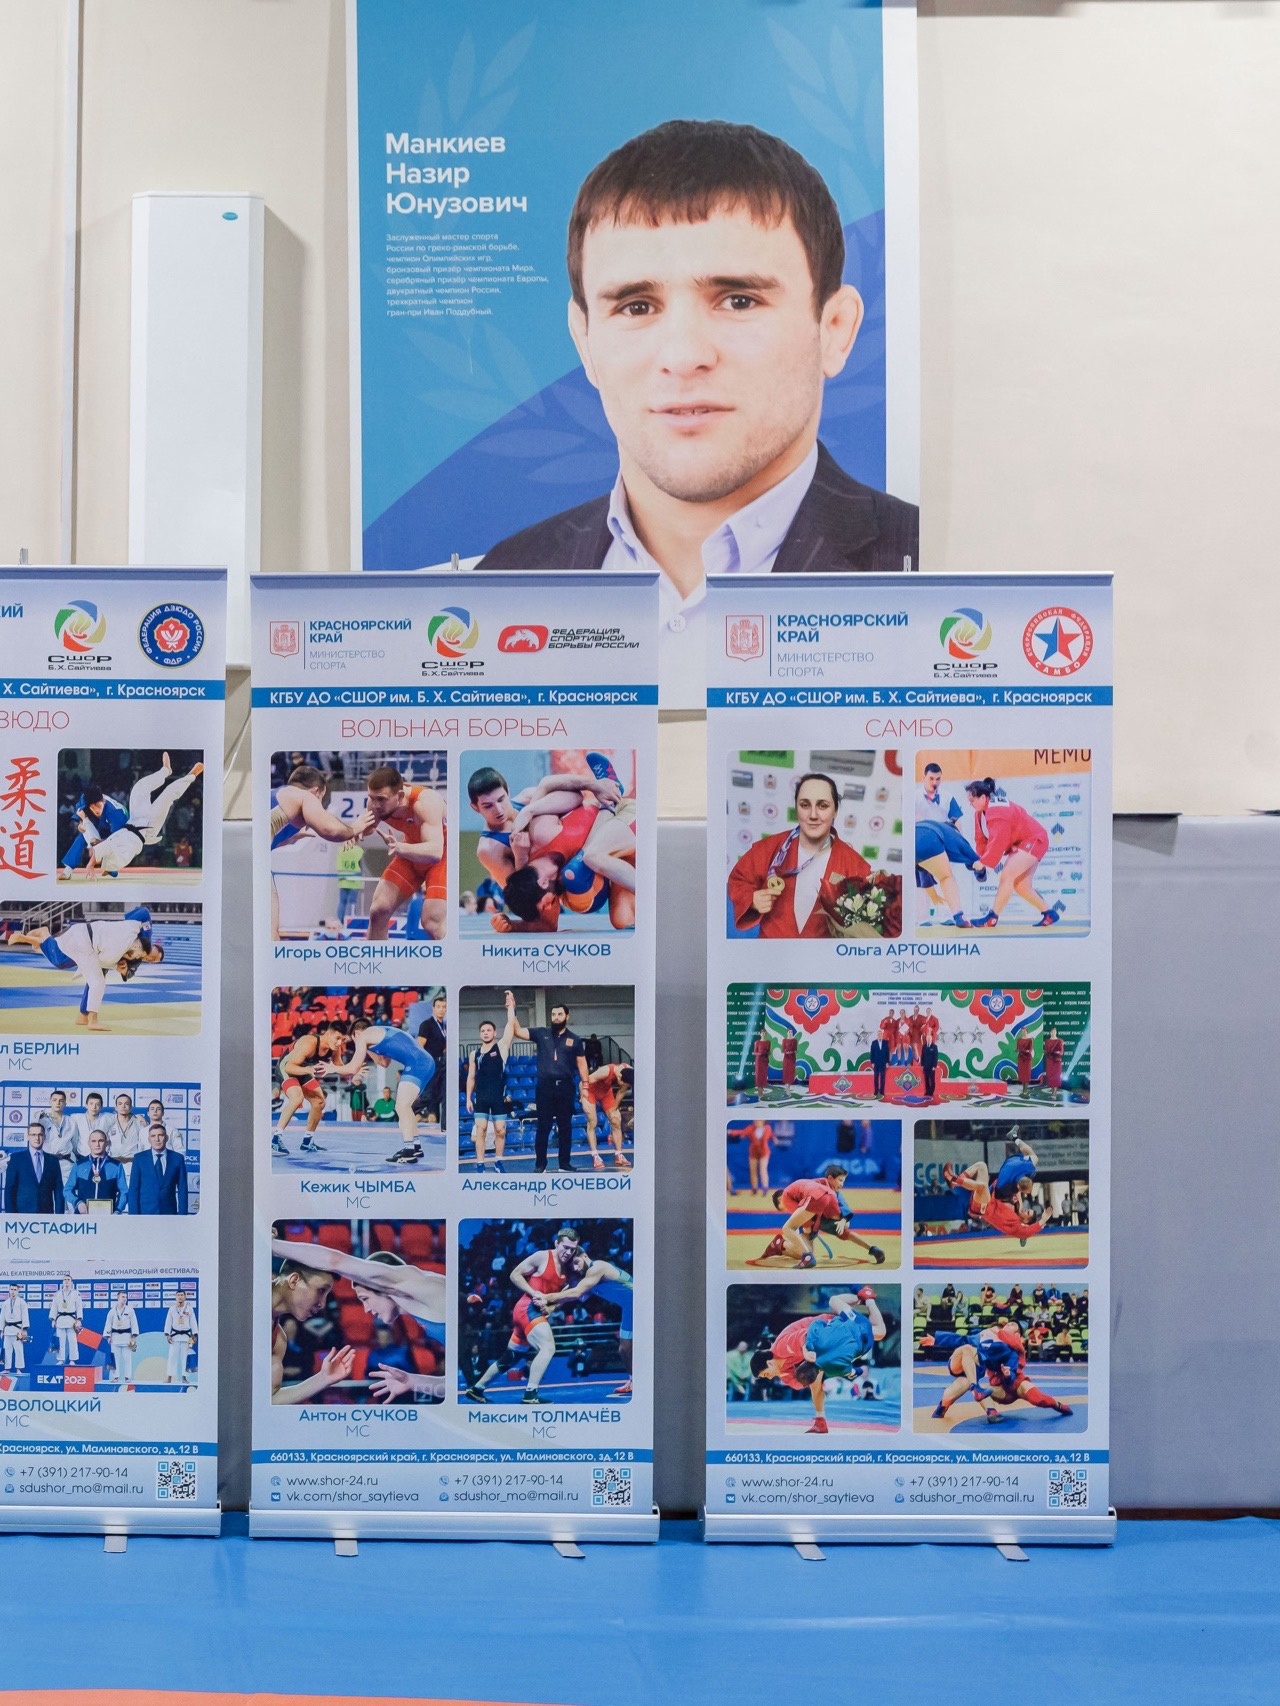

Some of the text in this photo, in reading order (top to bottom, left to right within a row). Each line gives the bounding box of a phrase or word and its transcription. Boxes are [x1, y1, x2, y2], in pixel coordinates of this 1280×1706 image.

[385, 131, 506, 155] Манкиев
[386, 162, 470, 189] Назир
[387, 192, 527, 220] Юнузович
[386, 233, 440, 242] Заслуженный
[310, 618, 412, 631] КРАСНОЯРСКИЙ
[777, 611, 908, 627] КРАСНОЯРСКИЙ
[310, 633, 343, 643] КРАЙ
[777, 630, 819, 643] КРАЙ
[310, 650, 386, 659] МИНИСТЕРСТВО
[777, 652, 874, 663] МИНИСТЕРСТВО
[309, 661, 347, 670] СПОРТА
[777, 667, 825, 678] СПОРТА
[3, 682, 16, 695] Х.
[20, 683, 100, 698] Сайтиева»,
[106, 686, 114, 696] г.
[118, 684, 206, 698] Красноярск
[270, 690, 638, 705] КГБУ ДО «СШОР им. Б. Х. Сайтиева», г. Красноярск
[726, 690, 1092, 706] КГБУ ДО «СШОР им. Б. Х. Сайтиева», г. Красноярск
[342, 718, 568, 738] ВОЛЬНАЯ БОРЬБА
[865, 718, 953, 738] САМБО
[274, 946, 443, 961] Игорь ОВСЯННИКОВ
[482, 944, 611, 957] Никита СУЧКОВ
[836, 943, 981, 956] Ольга АРТОШИНА
[334, 962, 382, 975] МСМК
[522, 960, 570, 973] МСМК
[891, 960, 926, 974] ЗМС
[13, 1042, 80, 1056] БЕРЛИН
[8, 1058, 33, 1071] МС
[301, 1180, 416, 1193] Кежик ЧЫМБА
[462, 1174, 631, 1193] Александр КОЧЕВОЙ
[346, 1196, 371, 1209] МС
[534, 1194, 558, 1207] МС
[5, 1221, 97, 1235] МУСТАФИН
[7, 1236, 31, 1250] МС
[6, 1414, 30, 1428] МС
[299, 1409, 418, 1422] Антон СУЧКОВ
[468, 1410, 621, 1424] Максим ТОЛМАЧЁВ
[346, 1424, 370, 1438] МС
[532, 1426, 557, 1439] МС
[19, 1482, 144, 1495] sdushor_mo@mail.ru
[741, 1476, 834, 1488] www.shor-24.ru
[910, 1476, 1019, 1488] +7 (391) 217-90-14
[286, 1491, 419, 1504] vk.com/shor_saytieva
[454, 1490, 579, 1503] sdushor_mo@mail.ru
[741, 1492, 875, 1505] vk.com/shor_saytieva
[910, 1492, 1035, 1503] sdushor_mo@mail.ru
